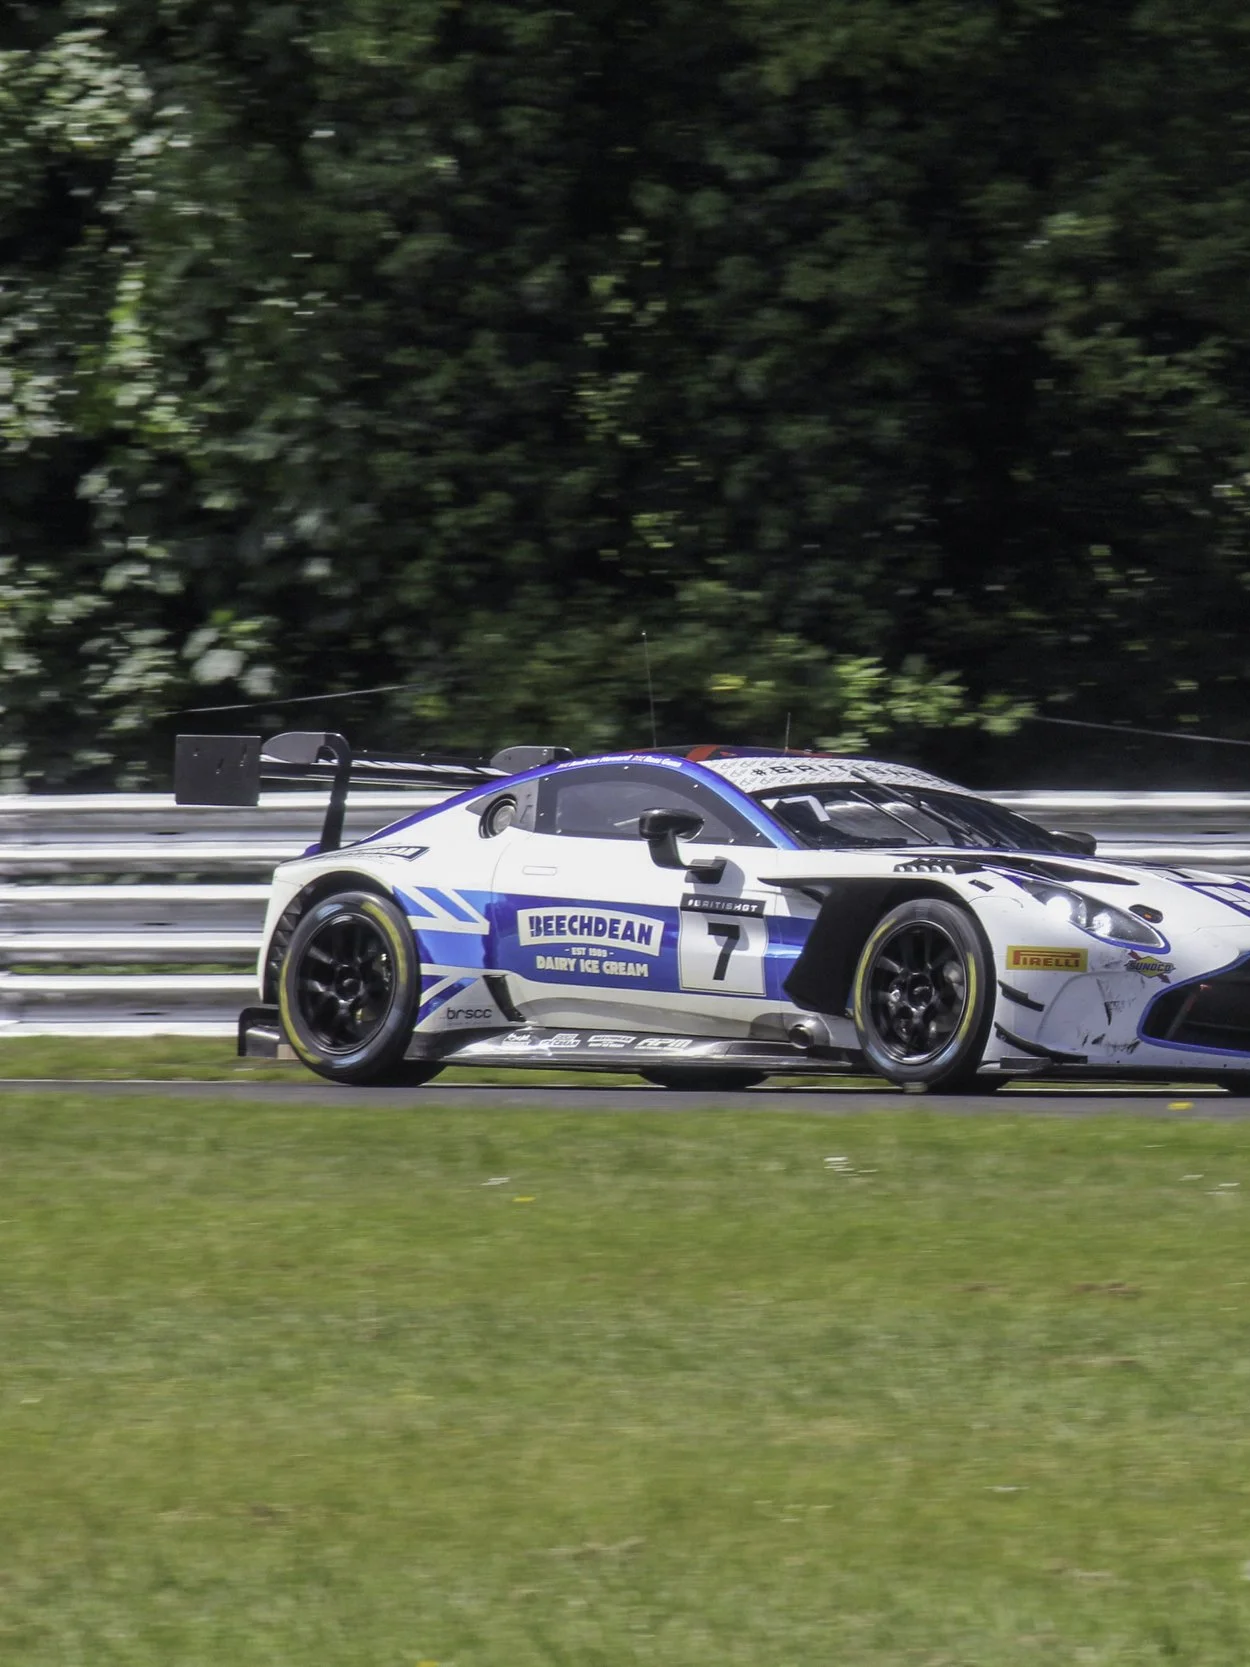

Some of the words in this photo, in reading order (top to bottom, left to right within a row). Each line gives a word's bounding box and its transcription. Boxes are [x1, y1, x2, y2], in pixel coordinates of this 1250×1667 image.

[687, 898, 758, 912] #BRITISHGT
[528, 914, 654, 946] BEECHDEAN
[571, 947, 587, 956] EST
[707, 921, 740, 981] 7
[1012, 949, 1081, 968] PIRELLI
[536, 955, 577, 972] DAIRY
[580, 958, 600, 974] ICE
[602, 960, 649, 978] CREAM
[1128, 959, 1174, 972] SUNOCO
[446, 1007, 493, 1020] brscc
